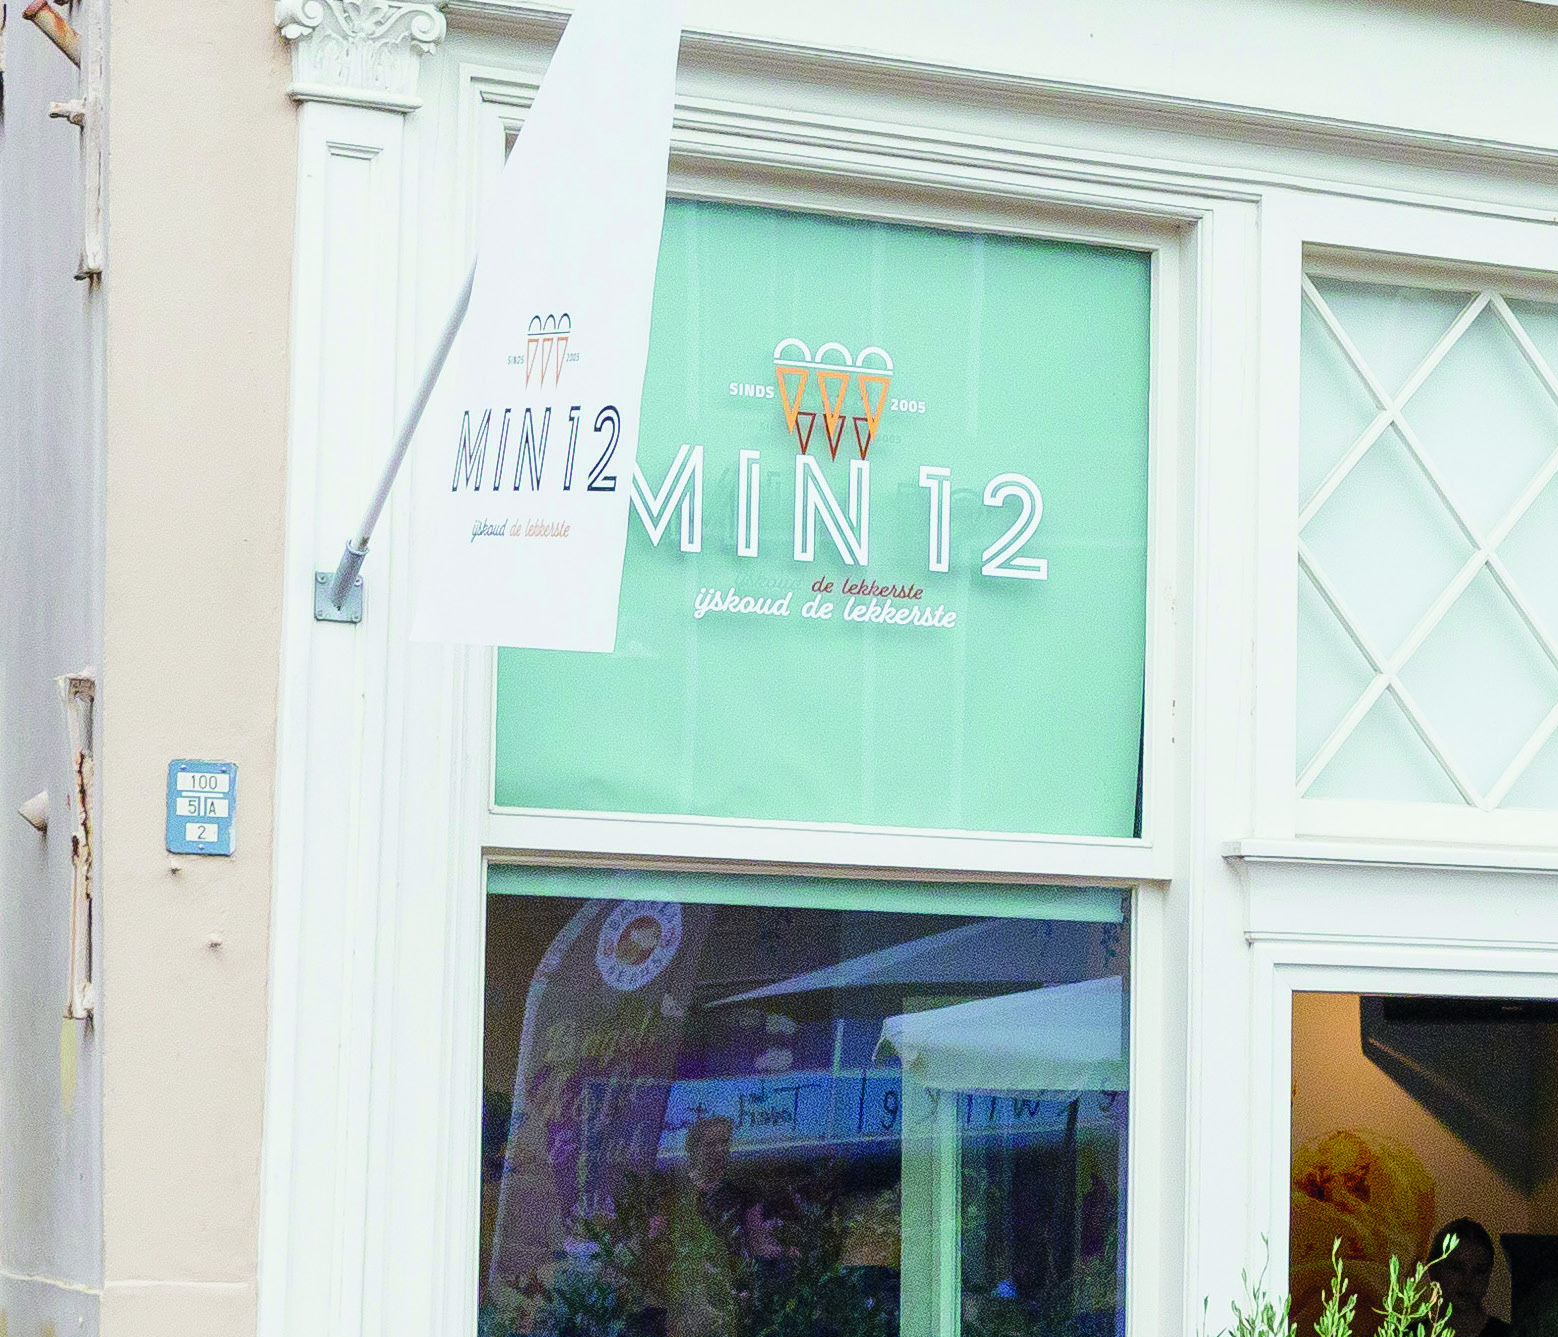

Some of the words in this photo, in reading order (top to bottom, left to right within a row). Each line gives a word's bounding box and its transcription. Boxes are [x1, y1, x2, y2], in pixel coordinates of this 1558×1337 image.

[729, 381, 775, 399] SINDS
[890, 397, 926, 414] 2005
[451, 406, 552, 492] MIN
[563, 404, 621, 492] 12
[629, 443, 871, 567] MIN
[919, 464, 1049, 581] 12
[811, 576, 834, 595] de
[842, 577, 924, 600] lekkerste
[693, 587, 792, 619] ijskoud
[801, 595, 834, 619] de
[843, 595, 957, 629] lekkerste
[191, 774, 218, 791] 100
[187, 799, 197, 814] 5
[208, 800, 217, 816] A
[197, 825, 207, 841] 2
